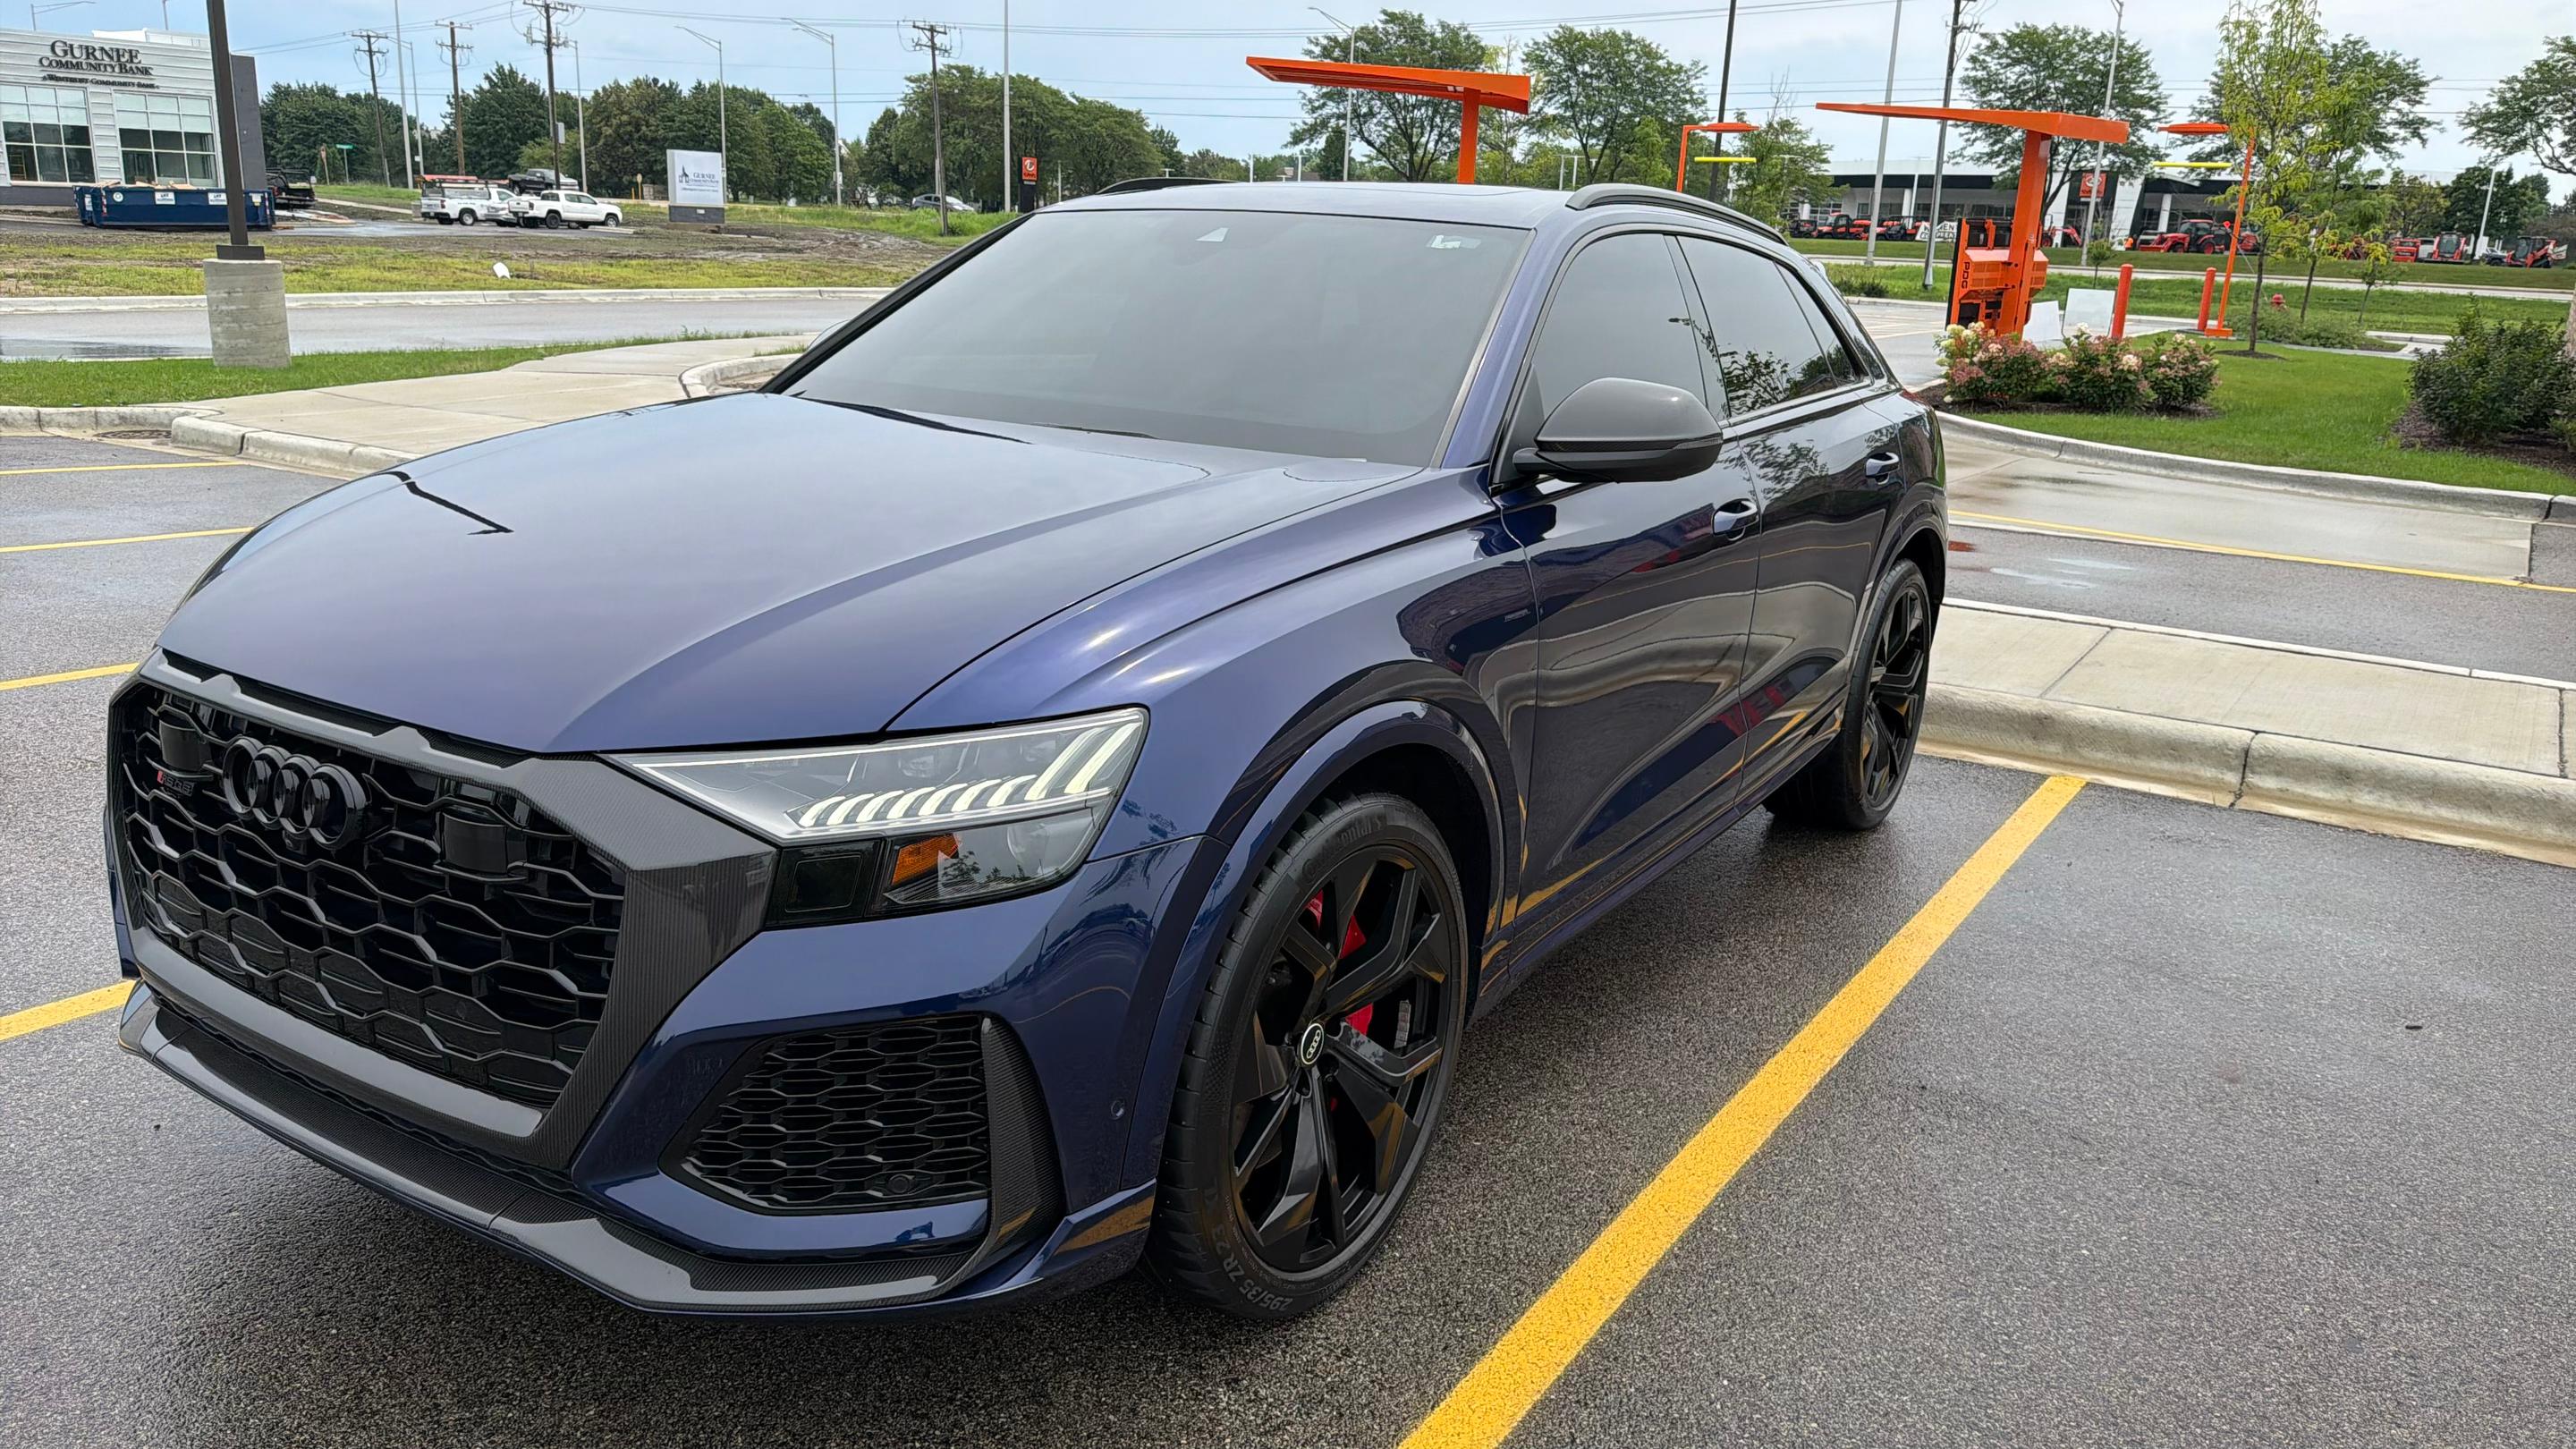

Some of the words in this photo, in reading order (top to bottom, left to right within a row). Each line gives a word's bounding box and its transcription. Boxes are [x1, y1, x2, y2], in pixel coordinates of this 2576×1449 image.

[38, 56, 119, 73] COMMUNITY
[117, 63, 154, 76] BANK
[50, 40, 142, 64] GURNEE
[1212, 1224, 1232, 1254] 23
[1223, 1252, 1244, 1283] ZR
[1239, 1278, 1293, 1310] 295/35
